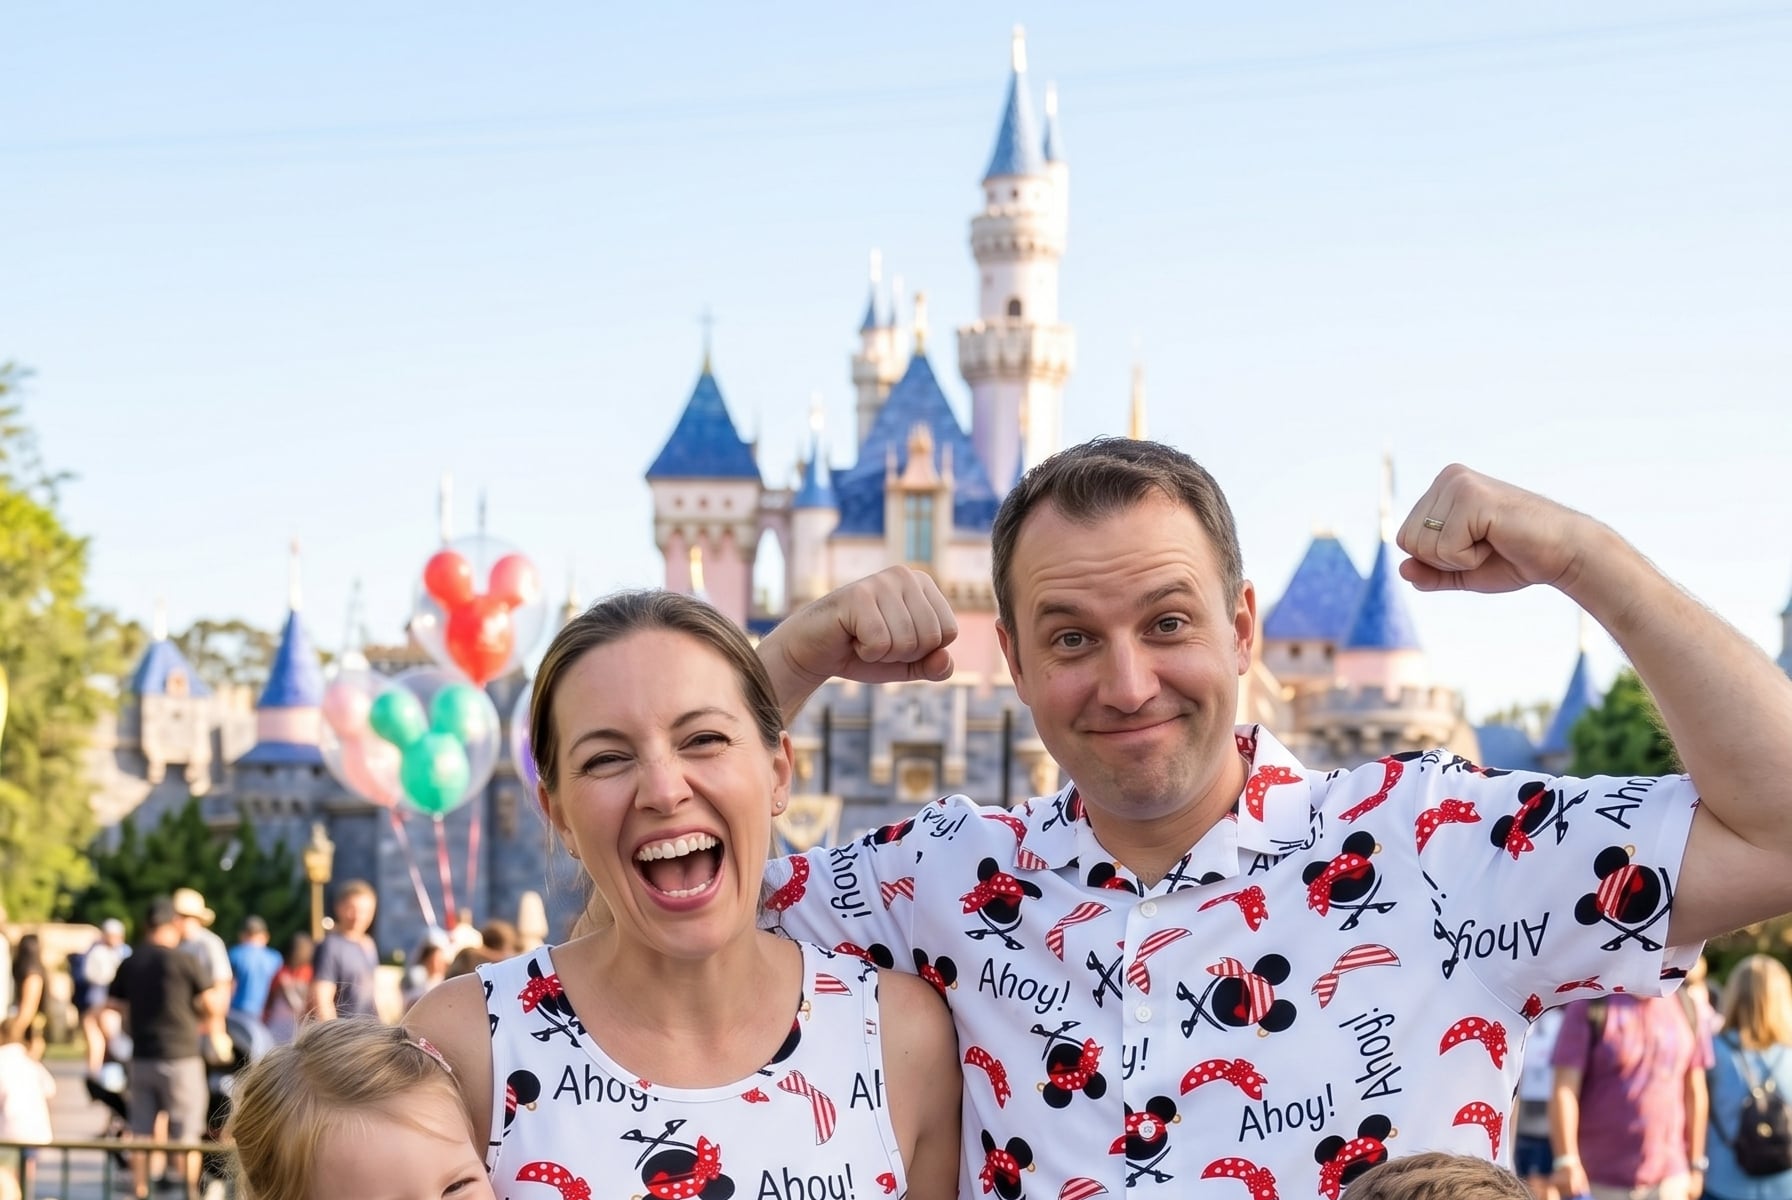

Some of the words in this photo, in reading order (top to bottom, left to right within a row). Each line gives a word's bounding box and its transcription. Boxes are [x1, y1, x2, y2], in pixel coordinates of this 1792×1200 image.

[978, 955, 1071, 1015] Ahoy!
[1338, 1007, 1402, 1101] Ahoy!
[552, 1063, 659, 1112] Ahoy
[1238, 1083, 1336, 1143] Ahoy!
